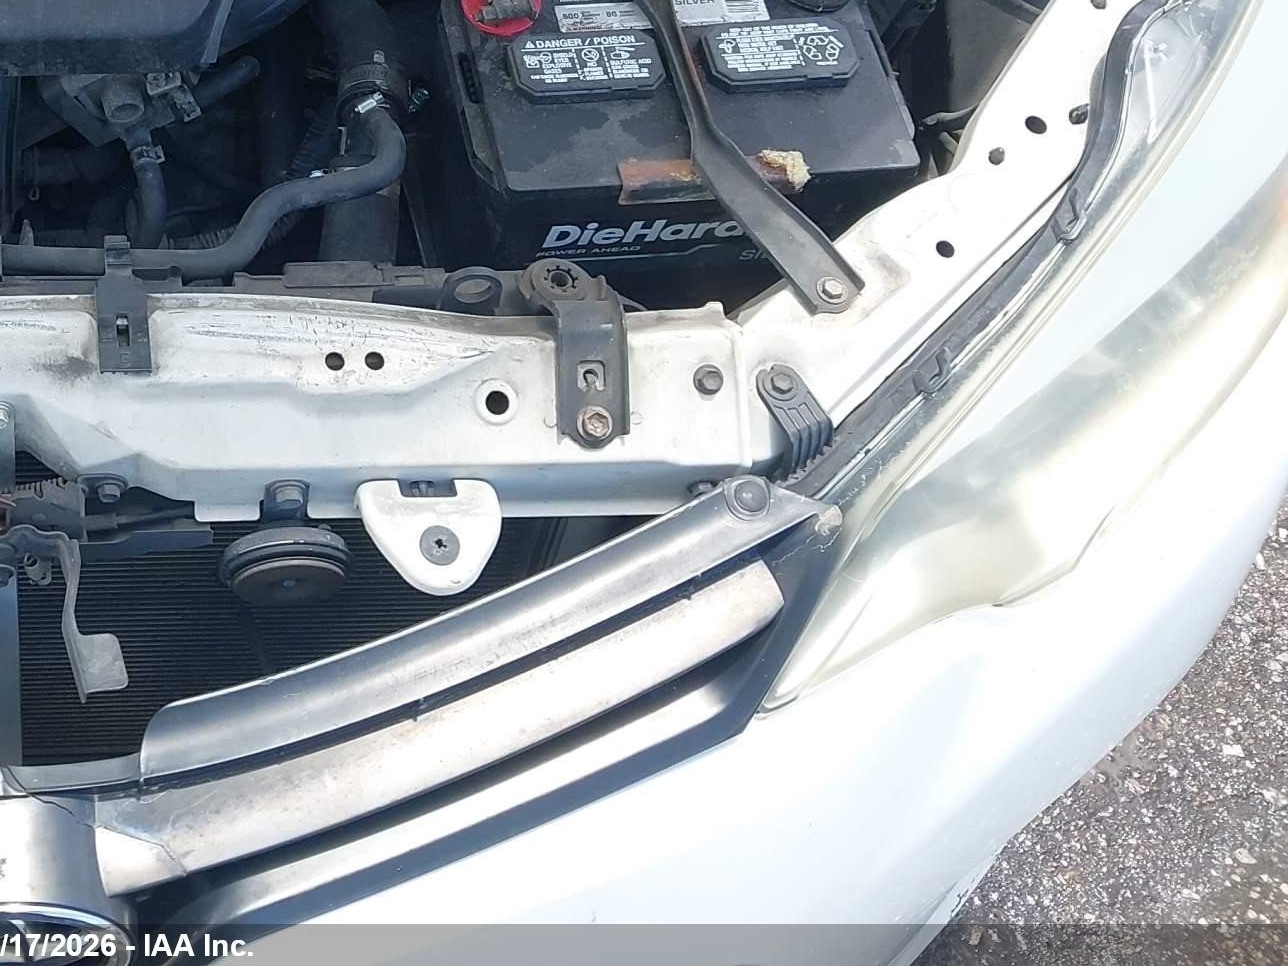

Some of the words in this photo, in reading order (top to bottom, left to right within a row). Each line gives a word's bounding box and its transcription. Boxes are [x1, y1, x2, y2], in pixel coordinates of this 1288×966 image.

[535, 38, 583, 49] DANGER
[584, 37, 591, 46] /
[593, 35, 636, 45] POISON
[535, 248, 587, 258] POWER
[591, 245, 641, 254] AHEAD
